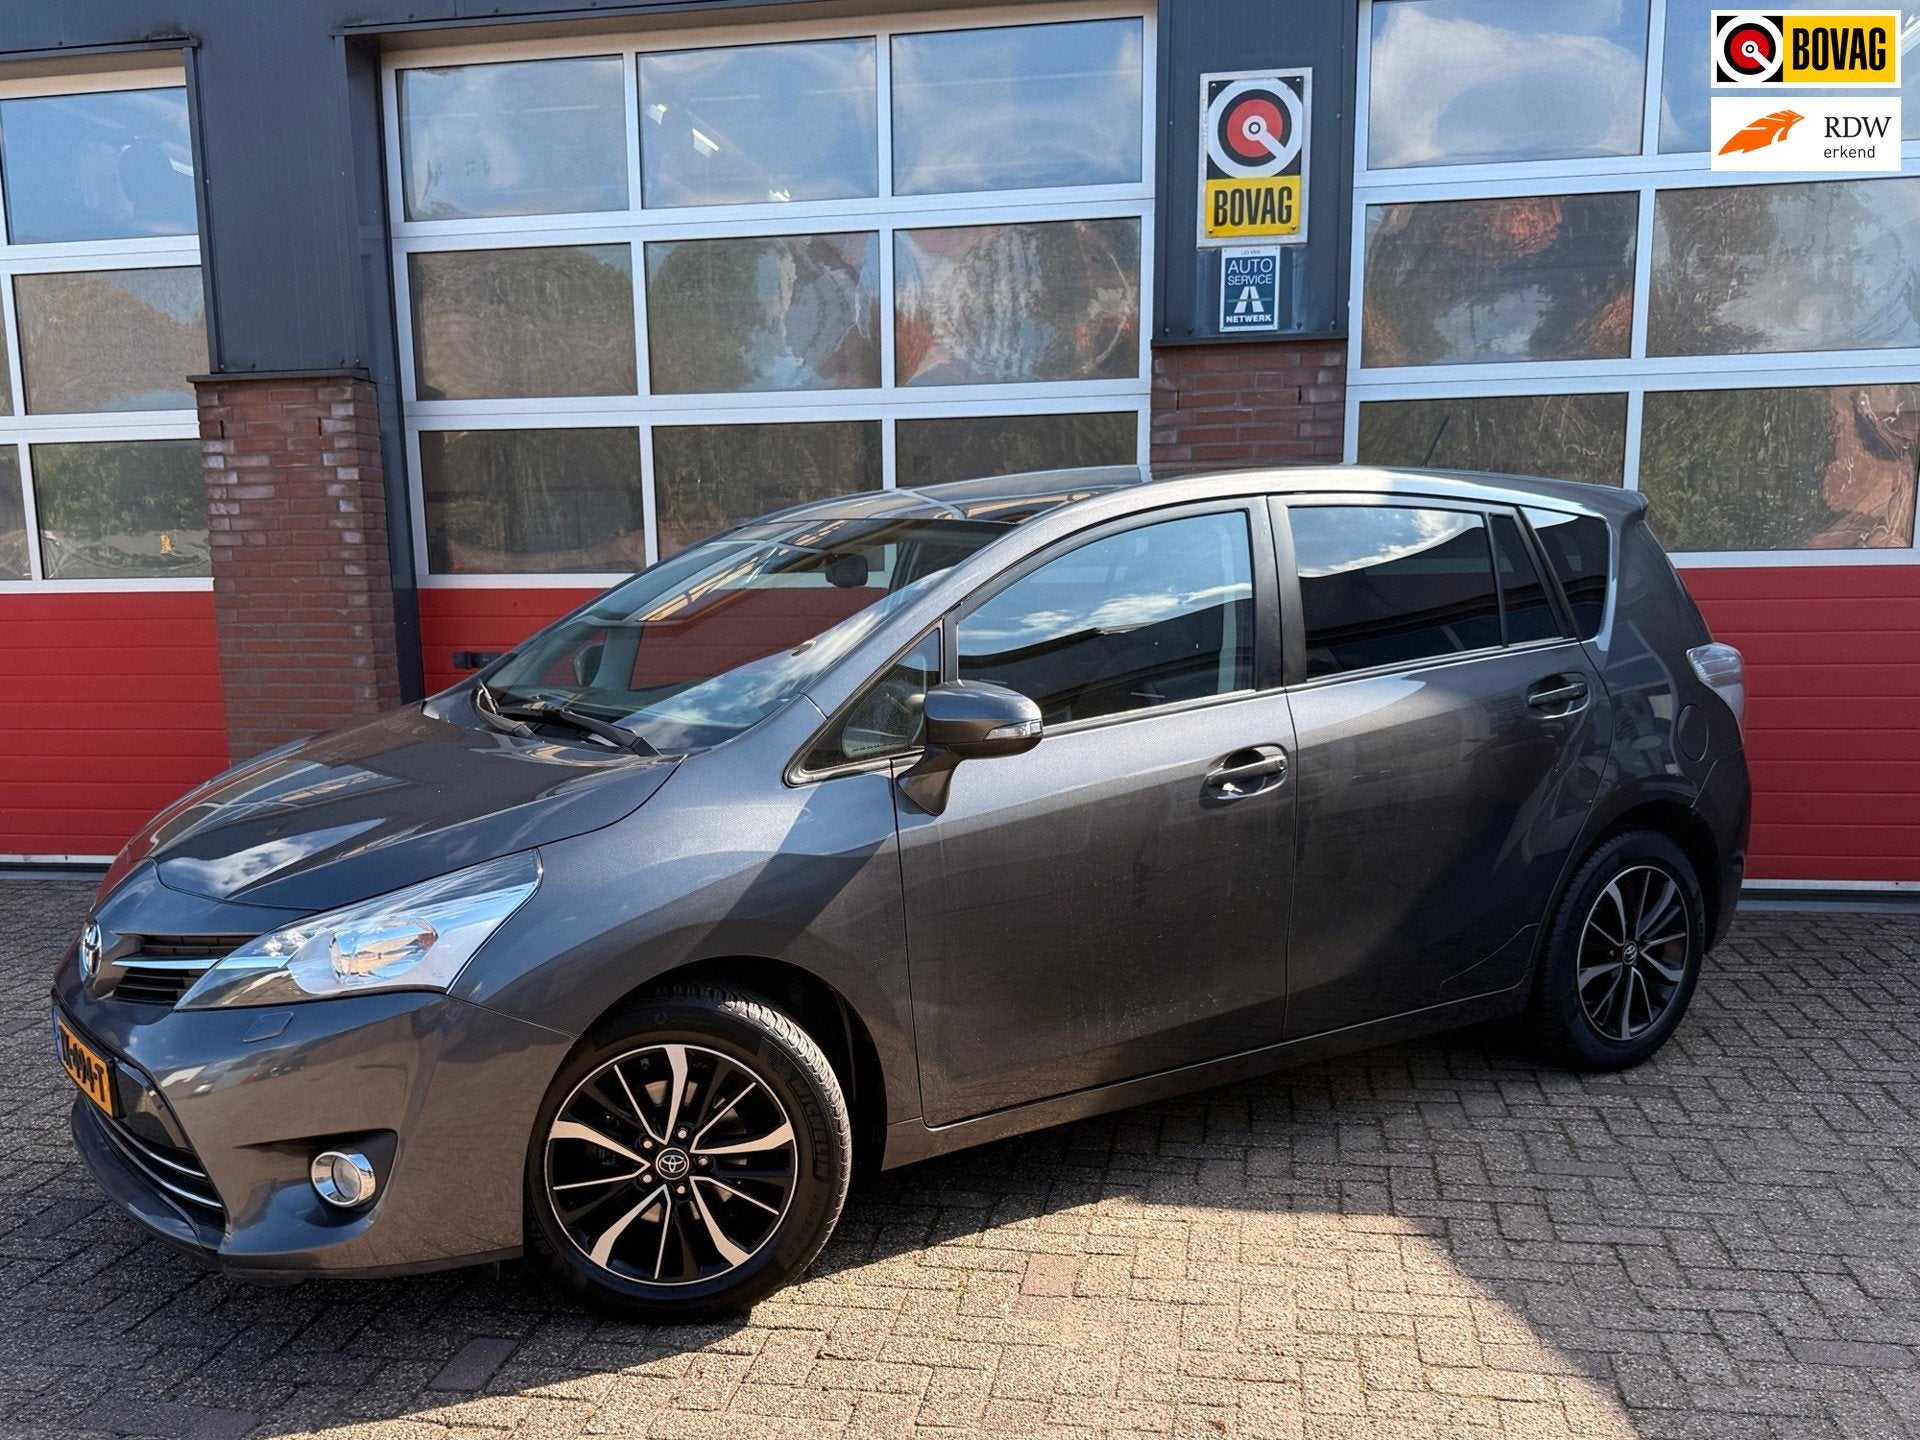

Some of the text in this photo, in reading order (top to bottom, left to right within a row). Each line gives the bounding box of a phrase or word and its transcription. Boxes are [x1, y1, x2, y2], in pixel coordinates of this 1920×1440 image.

[1214, 186, 1292, 226] BOVAG
[1227, 258, 1273, 274] AUTO
[1227, 274, 1272, 286] SERVICE
[1225, 314, 1272, 323] NETWERK
